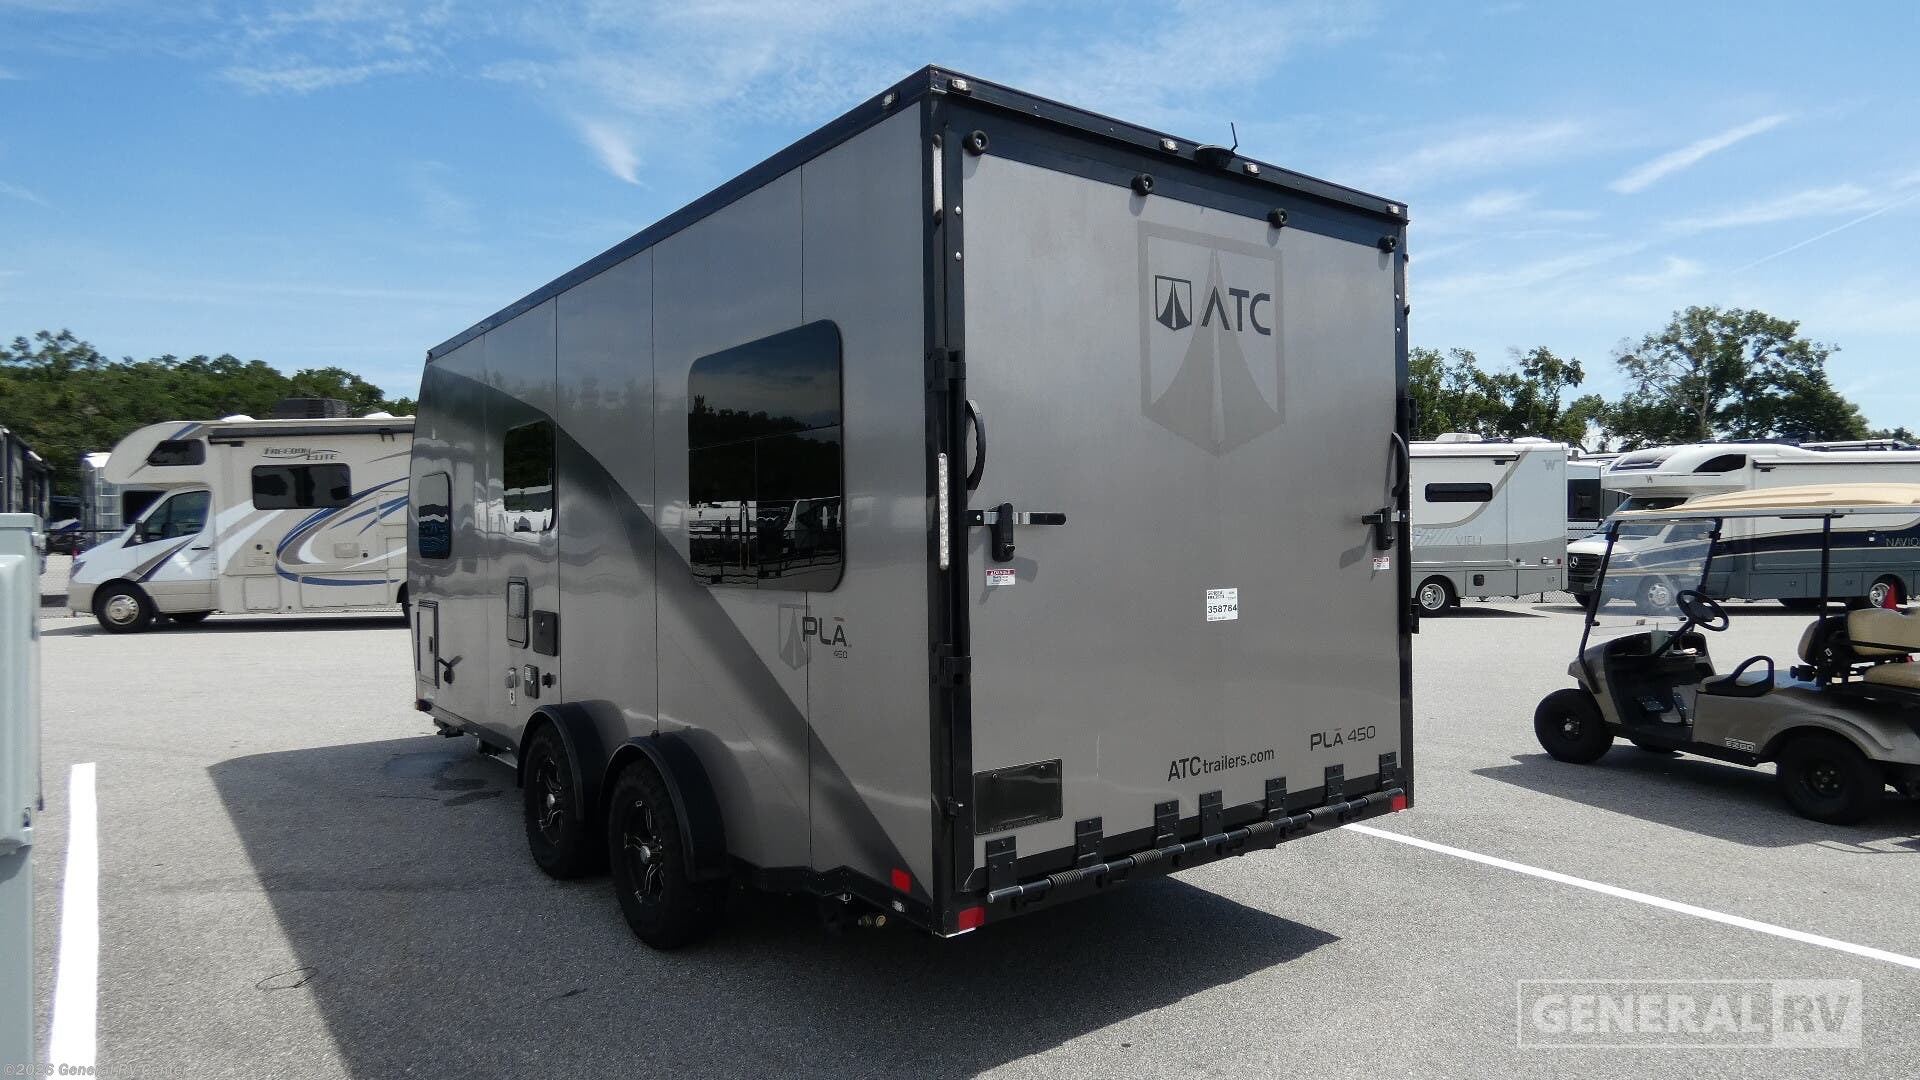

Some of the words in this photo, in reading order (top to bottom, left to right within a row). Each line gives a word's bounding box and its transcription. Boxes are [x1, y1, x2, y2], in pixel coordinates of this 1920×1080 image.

[1201, 286, 1271, 336] ATC
[1207, 604, 1237, 613] 358784
[1347, 725, 1376, 742] 450
